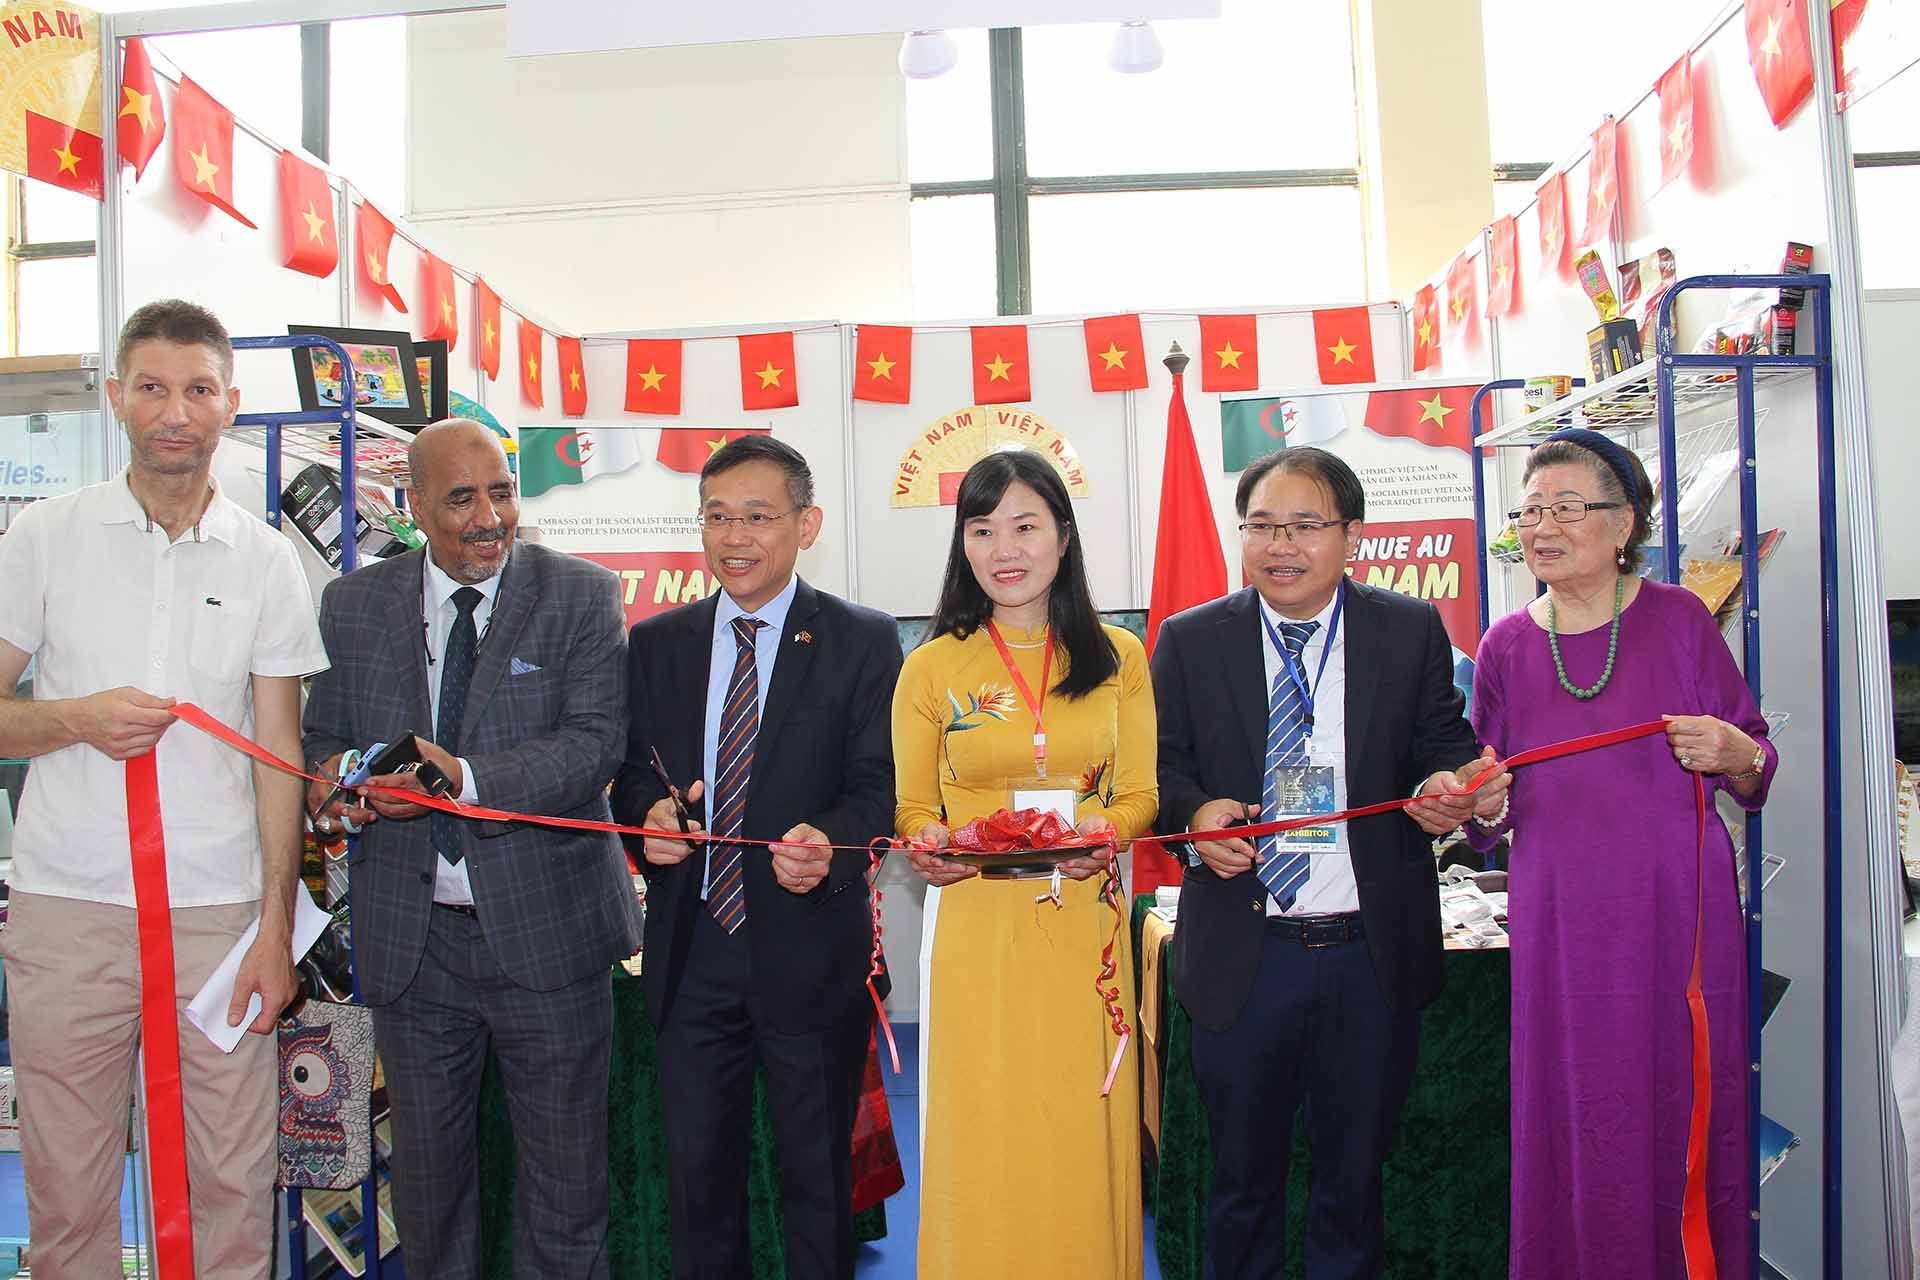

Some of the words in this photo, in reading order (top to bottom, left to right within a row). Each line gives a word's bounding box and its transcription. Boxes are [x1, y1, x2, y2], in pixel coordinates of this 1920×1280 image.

[2, 10, 83, 48] NAM
[895, 449, 922, 495] VIỆT
[925, 412, 973, 445] NAM
[997, 412, 1045, 437] VIỆT
[1049, 440, 1083, 486] NAM
[1418, 464, 1438, 472] NAM
[1367, 497, 1422, 506] MOCRATIQUE
[1371, 488, 1419, 497] SOCIALISTE
[1420, 488, 1433, 496] DU
[1434, 486, 1454, 494] VIET
[538, 517, 579, 526] EMBASSY
[581, 517, 593, 525] OF
[595, 517, 614, 525] THE
[614, 517, 660, 525] SOCIALIST
[548, 527, 565, 536] THE
[609, 527, 669, 536] DEMOCRATIC
[1416, 534, 1452, 558] AU
[653, 569, 720, 604] NA
[1366, 561, 1459, 600] NAM
